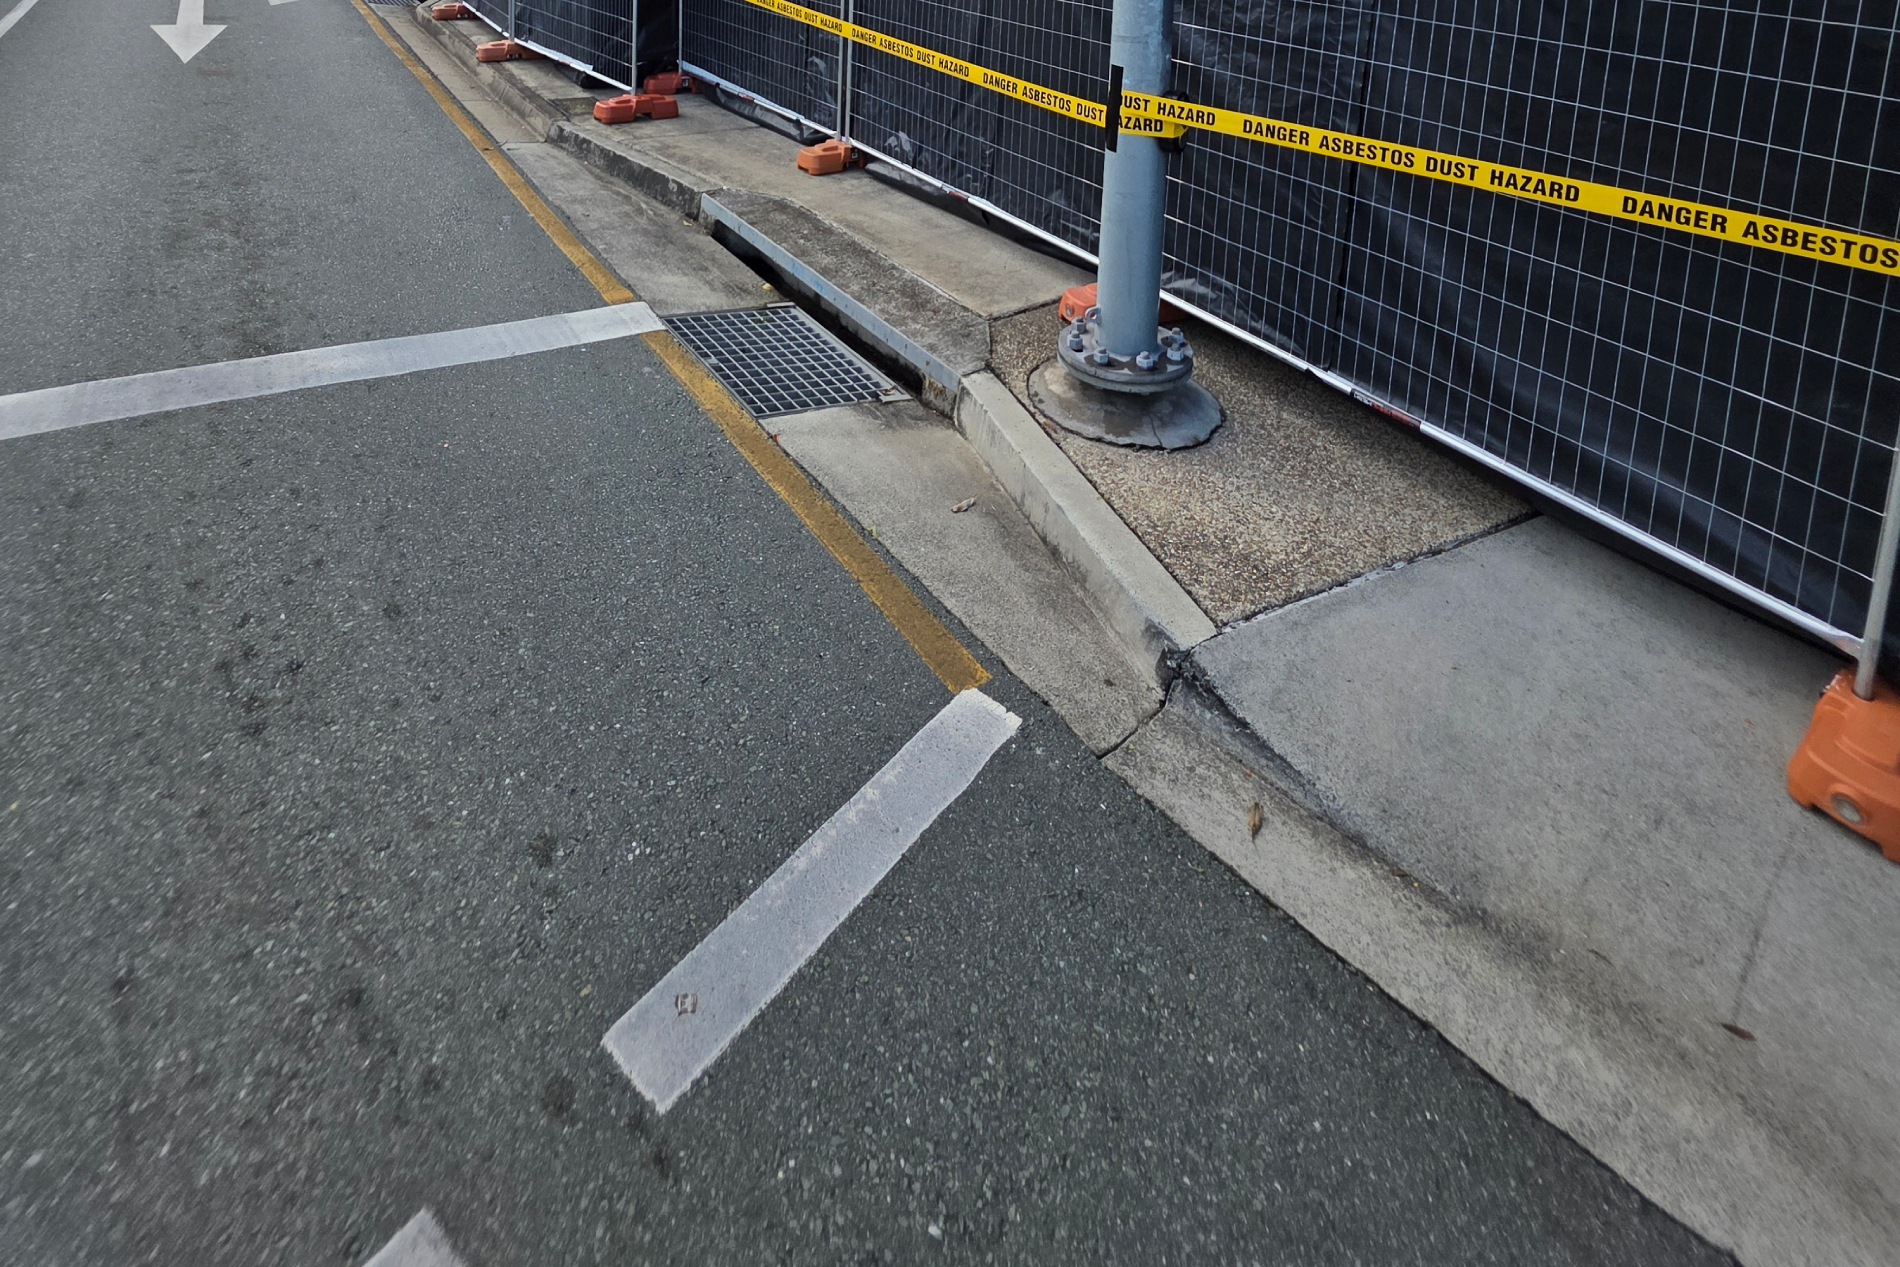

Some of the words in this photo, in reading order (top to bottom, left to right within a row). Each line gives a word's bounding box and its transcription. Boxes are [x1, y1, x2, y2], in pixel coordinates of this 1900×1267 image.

[777, 1, 802, 18] ASBESTOS
[804, 11, 818, 24] DUST
[820, 16, 843, 33] HAZARD
[851, 28, 877, 45] DANGER
[879, 37, 914, 59] ASBESTOS
[916, 49, 936, 66] DUST
[938, 56, 970, 78] HAZARD
[982, 72, 1018, 96] DANGER
[1021, 85, 1072, 113] ASBESTOS
[1075, 100, 1104, 123] DUST
[1123, 95, 1150, 112] UST
[1157, 101, 1216, 126] HAZARD
[1118, 115, 1164, 132] AZARD
[1242, 118, 1310, 147] DANGER
[1318, 134, 1415, 168] ASBESTOS
[1425, 155, 1480, 181] DUST
[1490, 168, 1580, 203] HAZARD
[1621, 195, 1729, 234] DANGER
[1741, 219, 1900, 269] ASBESTOS
